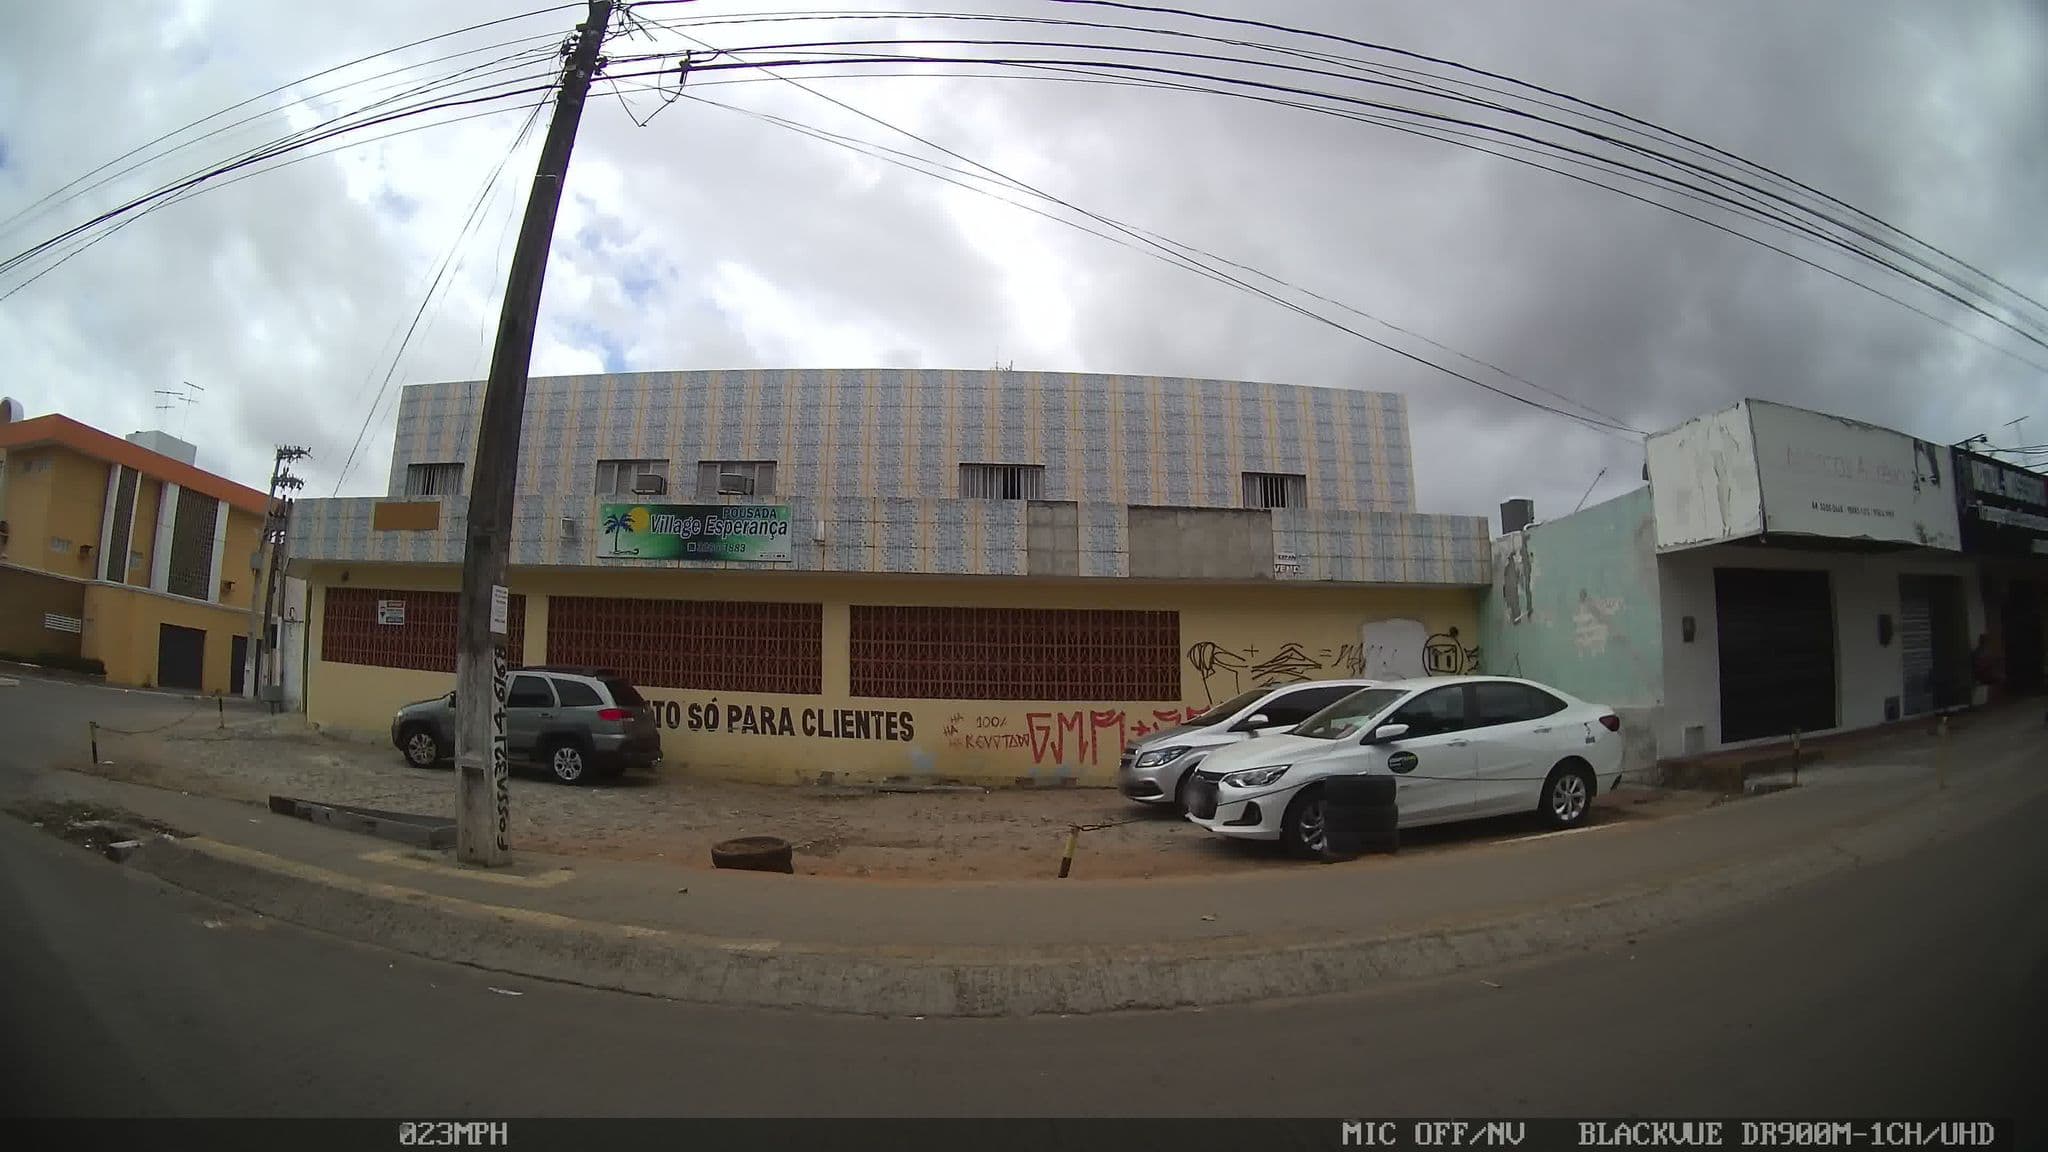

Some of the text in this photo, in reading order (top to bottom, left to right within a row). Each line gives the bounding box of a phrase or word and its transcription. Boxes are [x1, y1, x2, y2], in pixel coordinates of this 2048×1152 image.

[723, 507, 777, 519] POUSADA
[651, 515, 788, 540] Village Esperança
[688, 697, 720, 732] SÓ
[727, 704, 796, 736] PARA
[801, 707, 915, 741] CLIENTES
